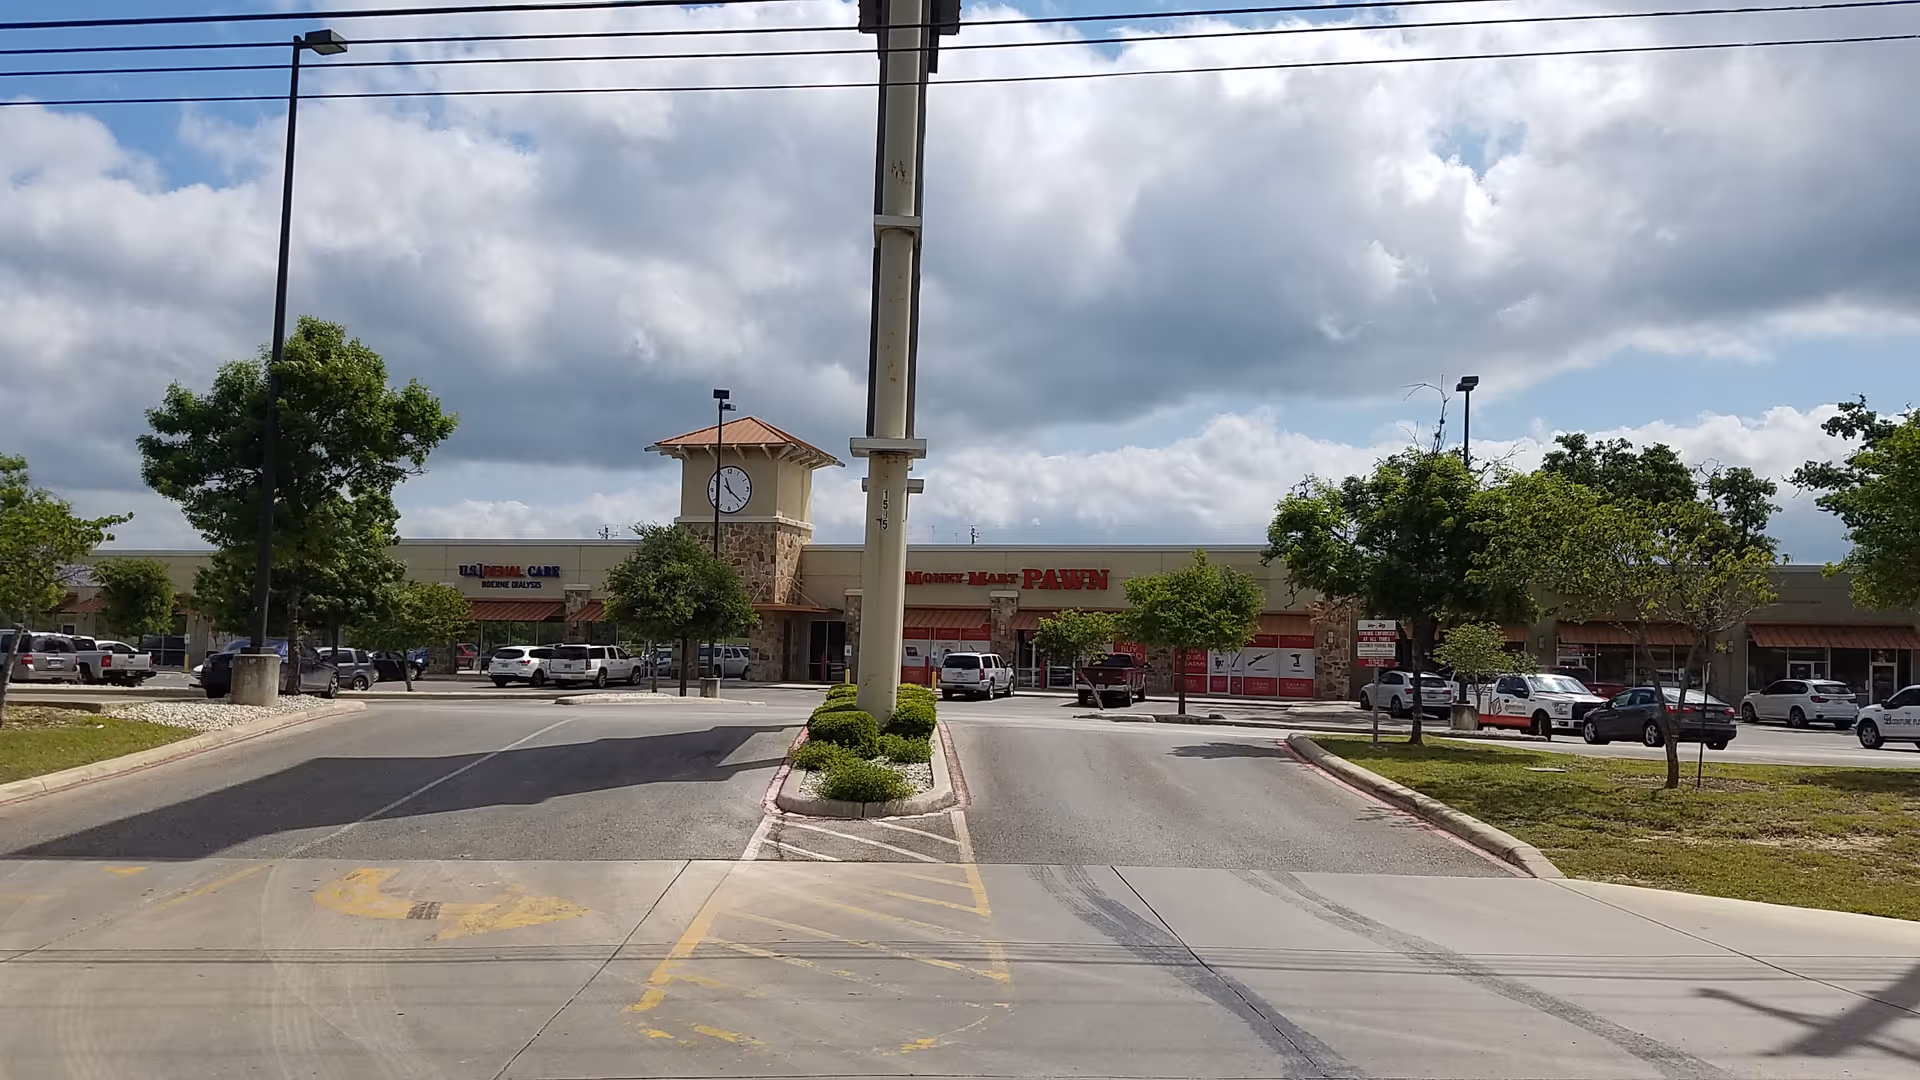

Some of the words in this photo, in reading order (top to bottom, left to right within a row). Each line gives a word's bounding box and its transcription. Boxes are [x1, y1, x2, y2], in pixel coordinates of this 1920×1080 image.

[527, 564, 561, 578] CARE
[481, 581, 510, 589] BOERNE
[511, 581, 542, 589] DIALYSIS
[1021, 568, 1111, 590] PAWN
